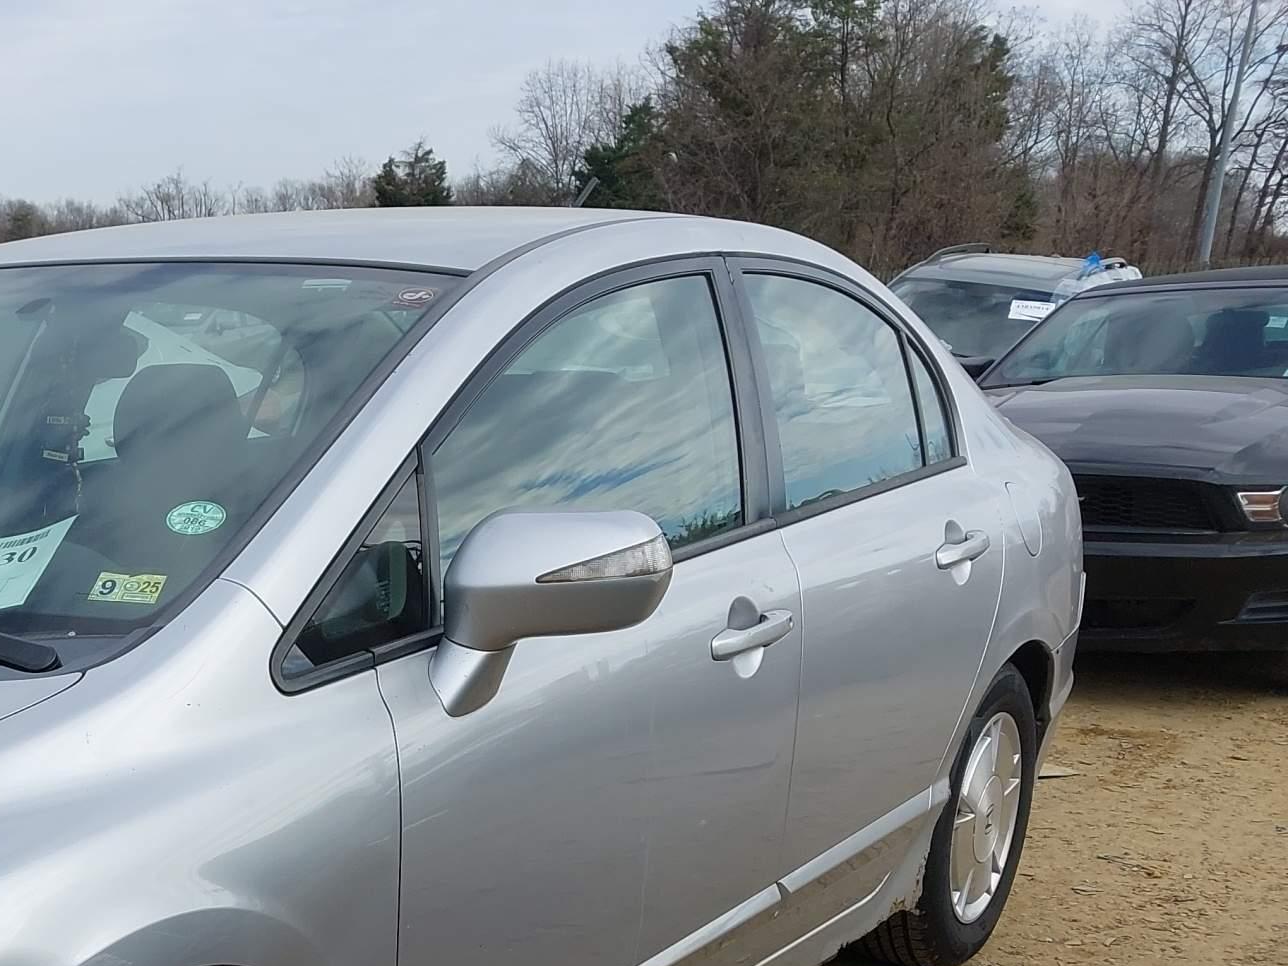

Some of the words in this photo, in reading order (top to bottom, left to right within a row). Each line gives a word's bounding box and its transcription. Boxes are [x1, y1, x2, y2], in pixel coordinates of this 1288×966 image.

[190, 504, 214, 514] CV
[98, 579, 117, 595] 9
[138, 580, 162, 594] 25
